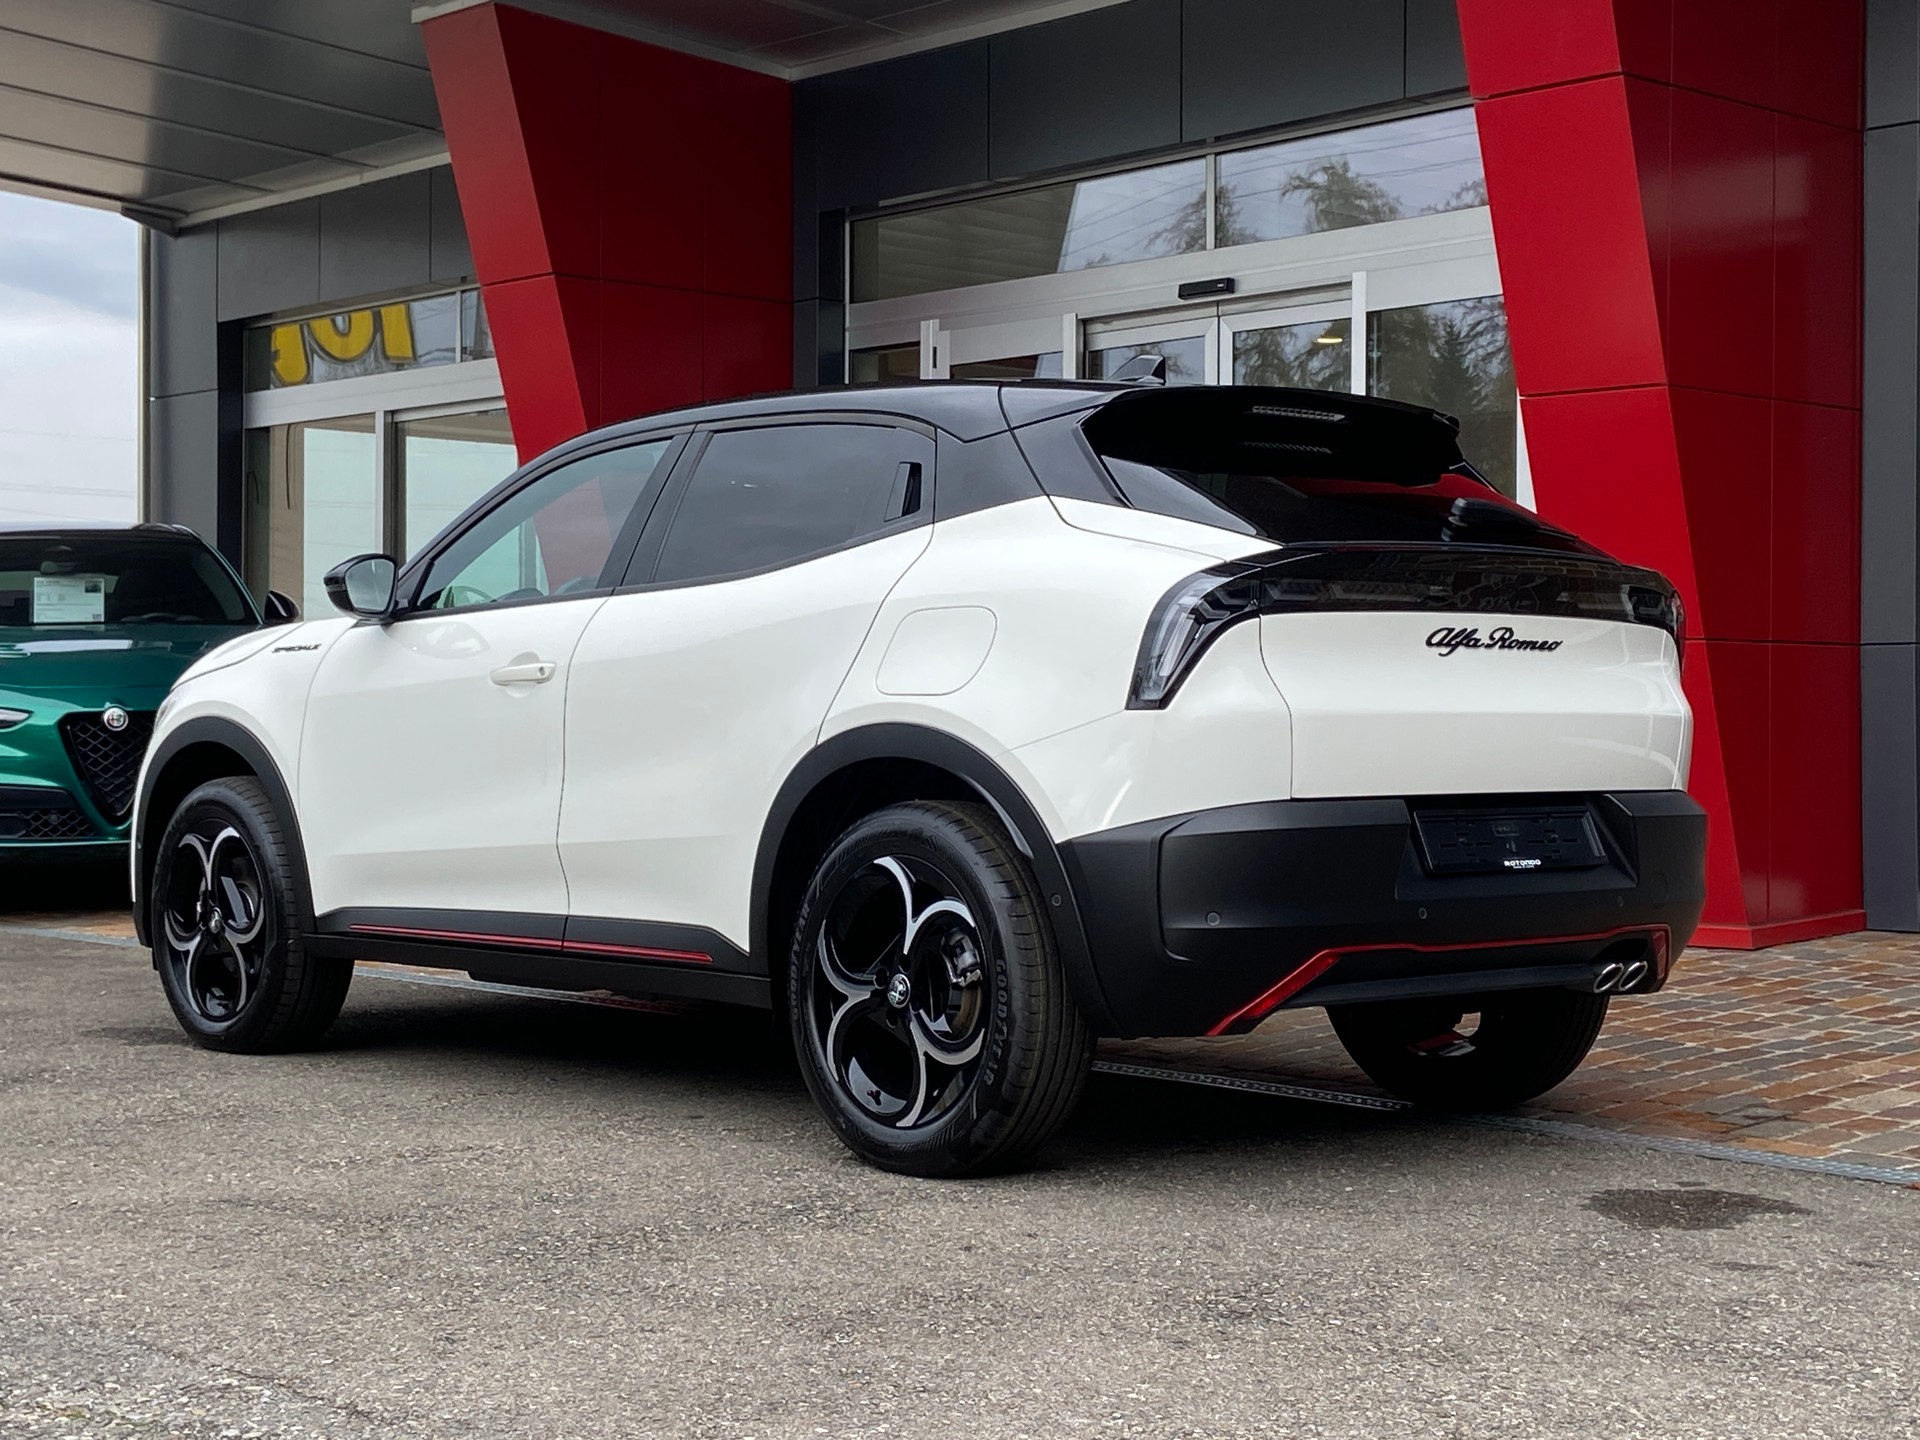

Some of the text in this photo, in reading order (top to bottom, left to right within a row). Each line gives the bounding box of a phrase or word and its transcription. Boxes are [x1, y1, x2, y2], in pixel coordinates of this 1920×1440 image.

[1425, 627, 1563, 657] Alfa Romeo
[983, 959, 1008, 1086] GOODYEAR
